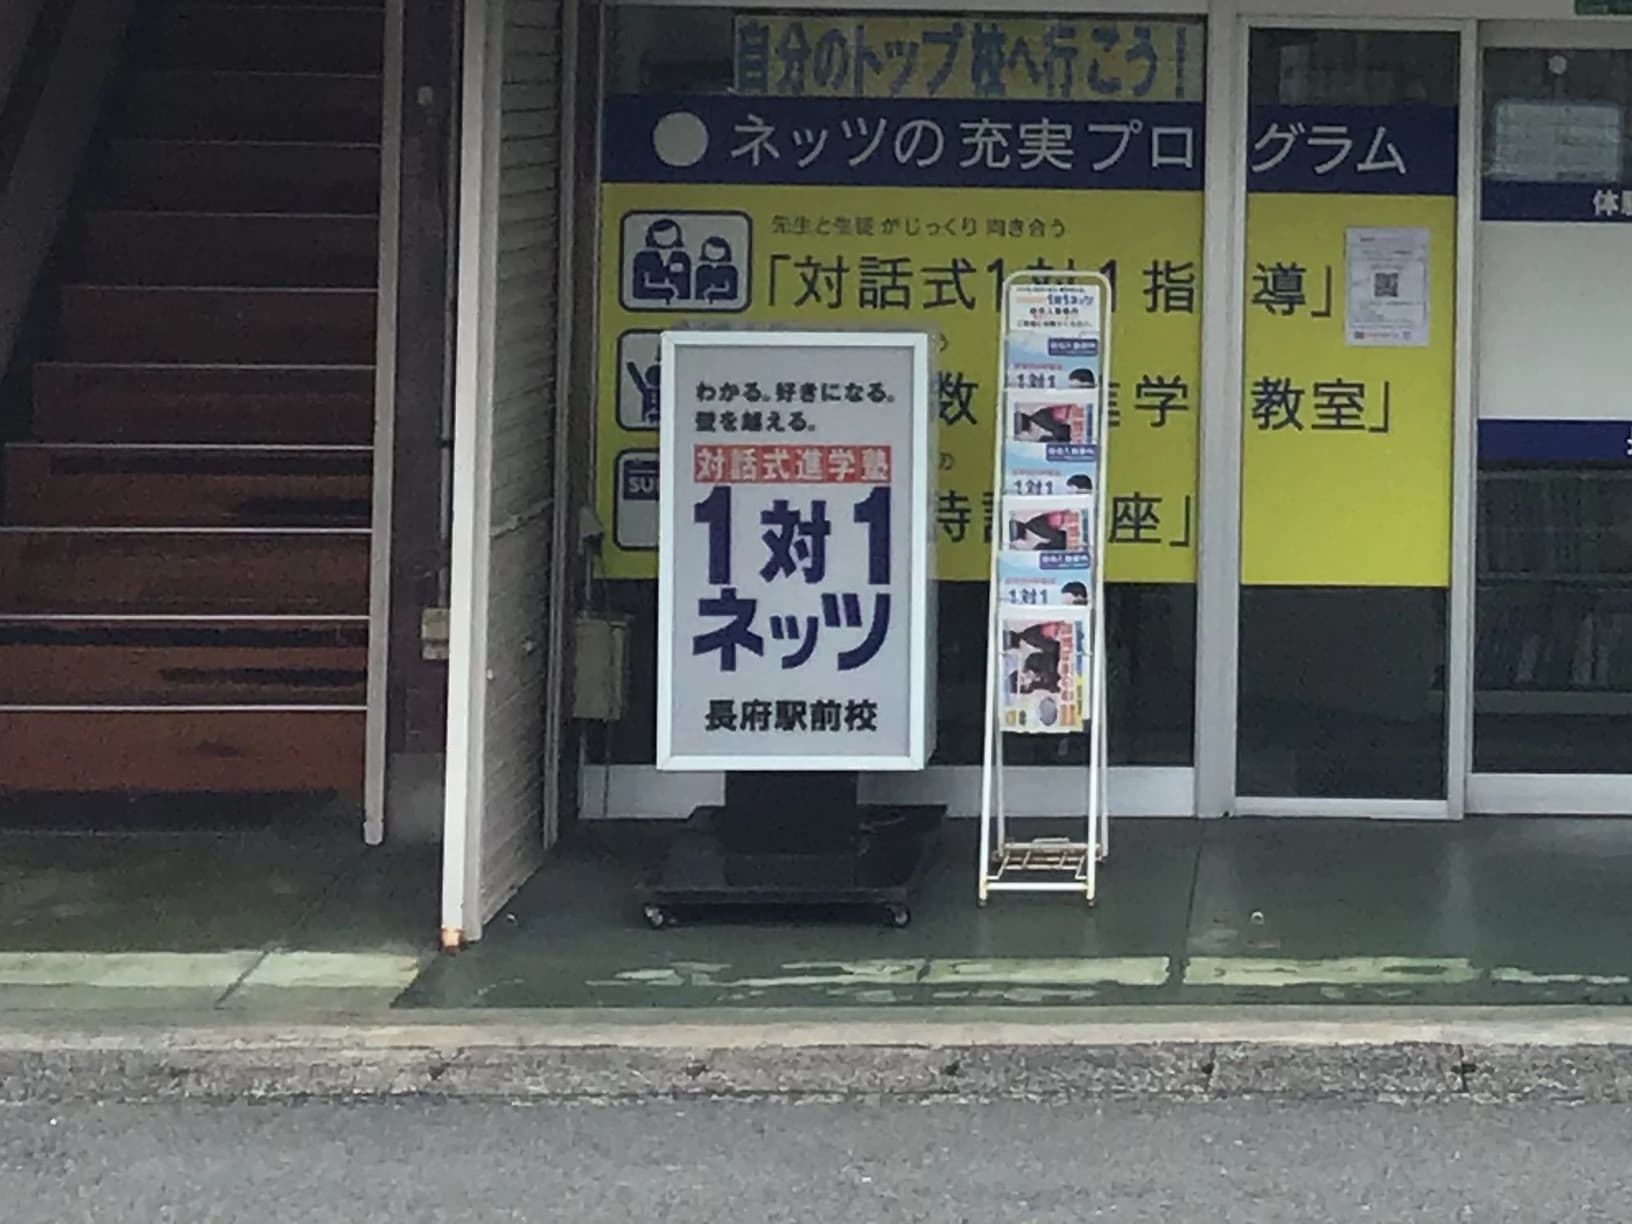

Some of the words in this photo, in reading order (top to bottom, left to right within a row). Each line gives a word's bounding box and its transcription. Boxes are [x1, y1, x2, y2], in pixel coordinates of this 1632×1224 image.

[696, 446, 890, 482] 対話式進学塾
[693, 485, 891, 585] 1対1
[692, 587, 891, 672] ネッツ
[705, 699, 878, 733] 長府駅前校
